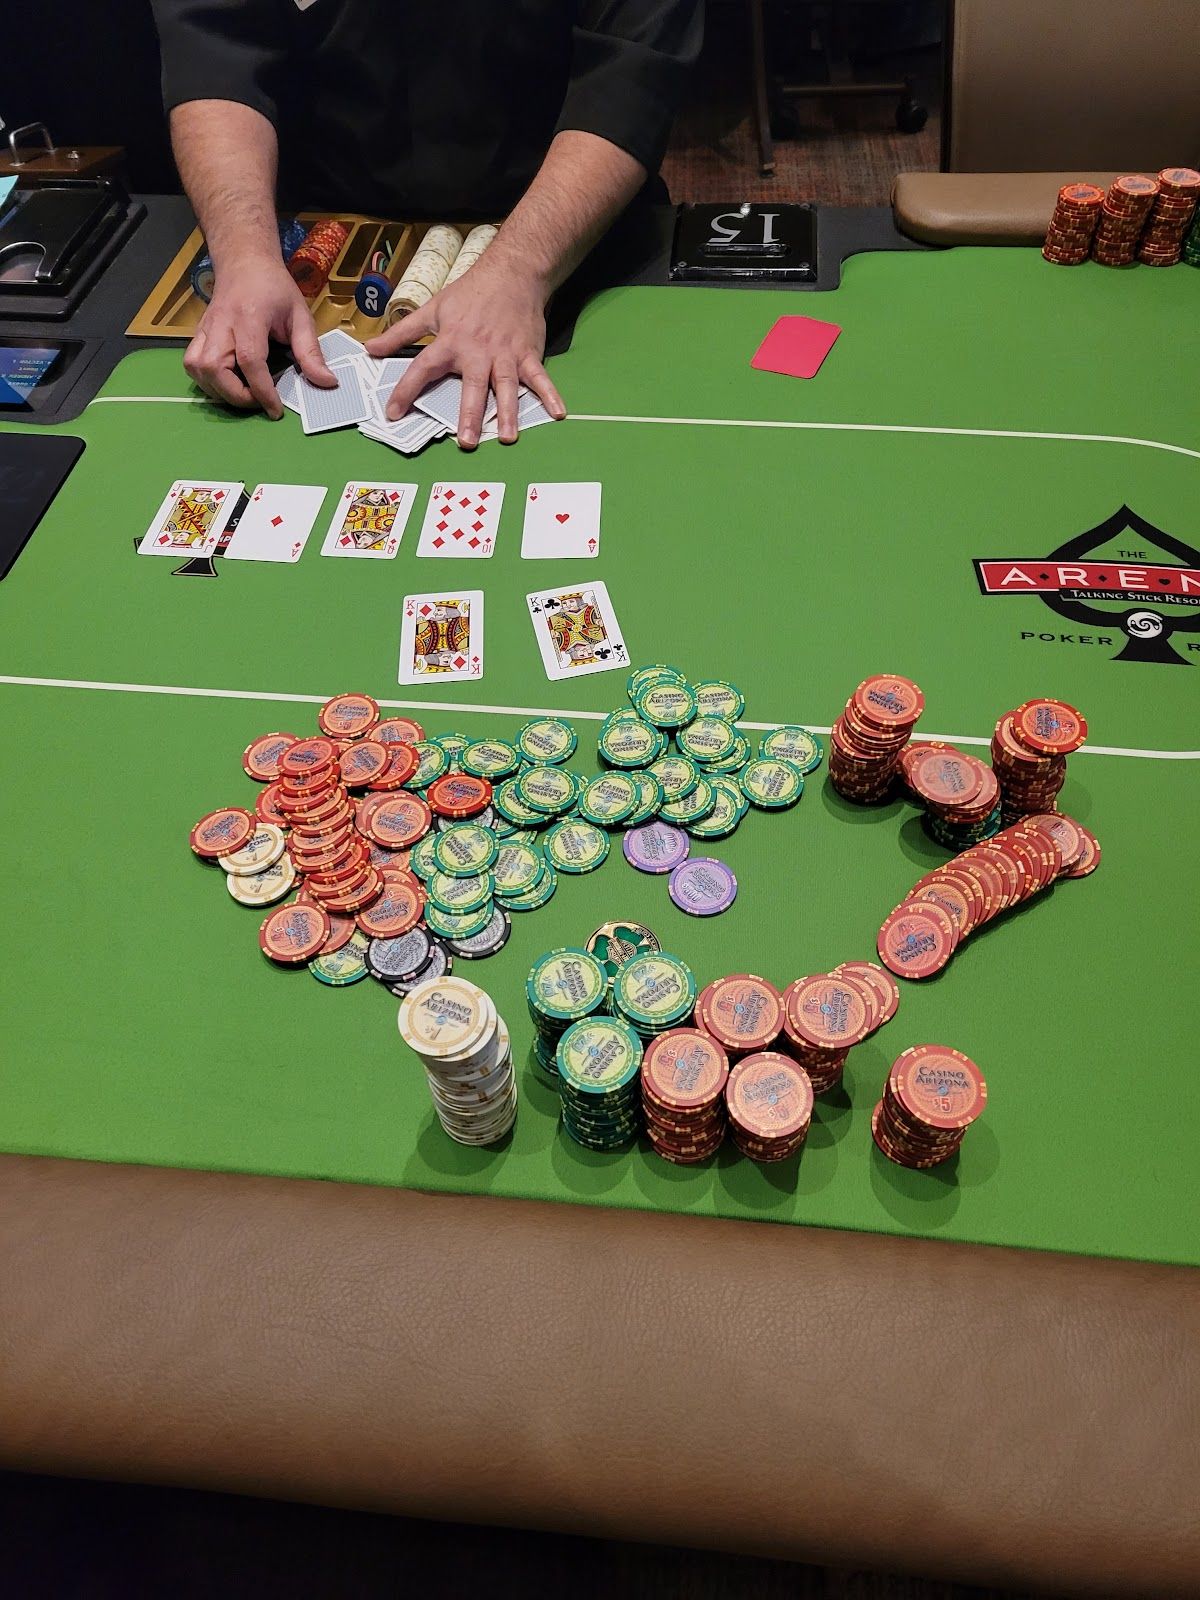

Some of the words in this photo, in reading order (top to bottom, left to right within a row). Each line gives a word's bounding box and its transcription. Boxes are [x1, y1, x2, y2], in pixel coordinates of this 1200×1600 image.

[708, 213, 781, 244] 15
[365, 286, 379, 312] 20
[256, 487, 264, 496] A
[433, 486, 443, 494] 10
[530, 488, 538, 496] A
[291, 548, 300, 557] A
[481, 544, 492, 553] 10
[587, 544, 597, 553] A
[1117, 550, 1148, 559] THE
[530, 597, 540, 606] K
[1069, 589, 1123, 600] TALKING
[1127, 592, 1163, 602] STICK
[406, 600, 415, 609] K
[1021, 632, 1114, 646] POKER
[617, 651, 628, 662] K
[471, 664, 481, 674] K
[571, 960, 588, 999] CASINO
[641, 983, 681, 1009] CASINO
[430, 991, 473, 1016] CASINO
[420, 998, 471, 1026] ARIZONA
[592, 1045, 626, 1079] CASINO
[919, 1066, 965, 1080] CASINO
[915, 1074, 969, 1089] ARIZONA
